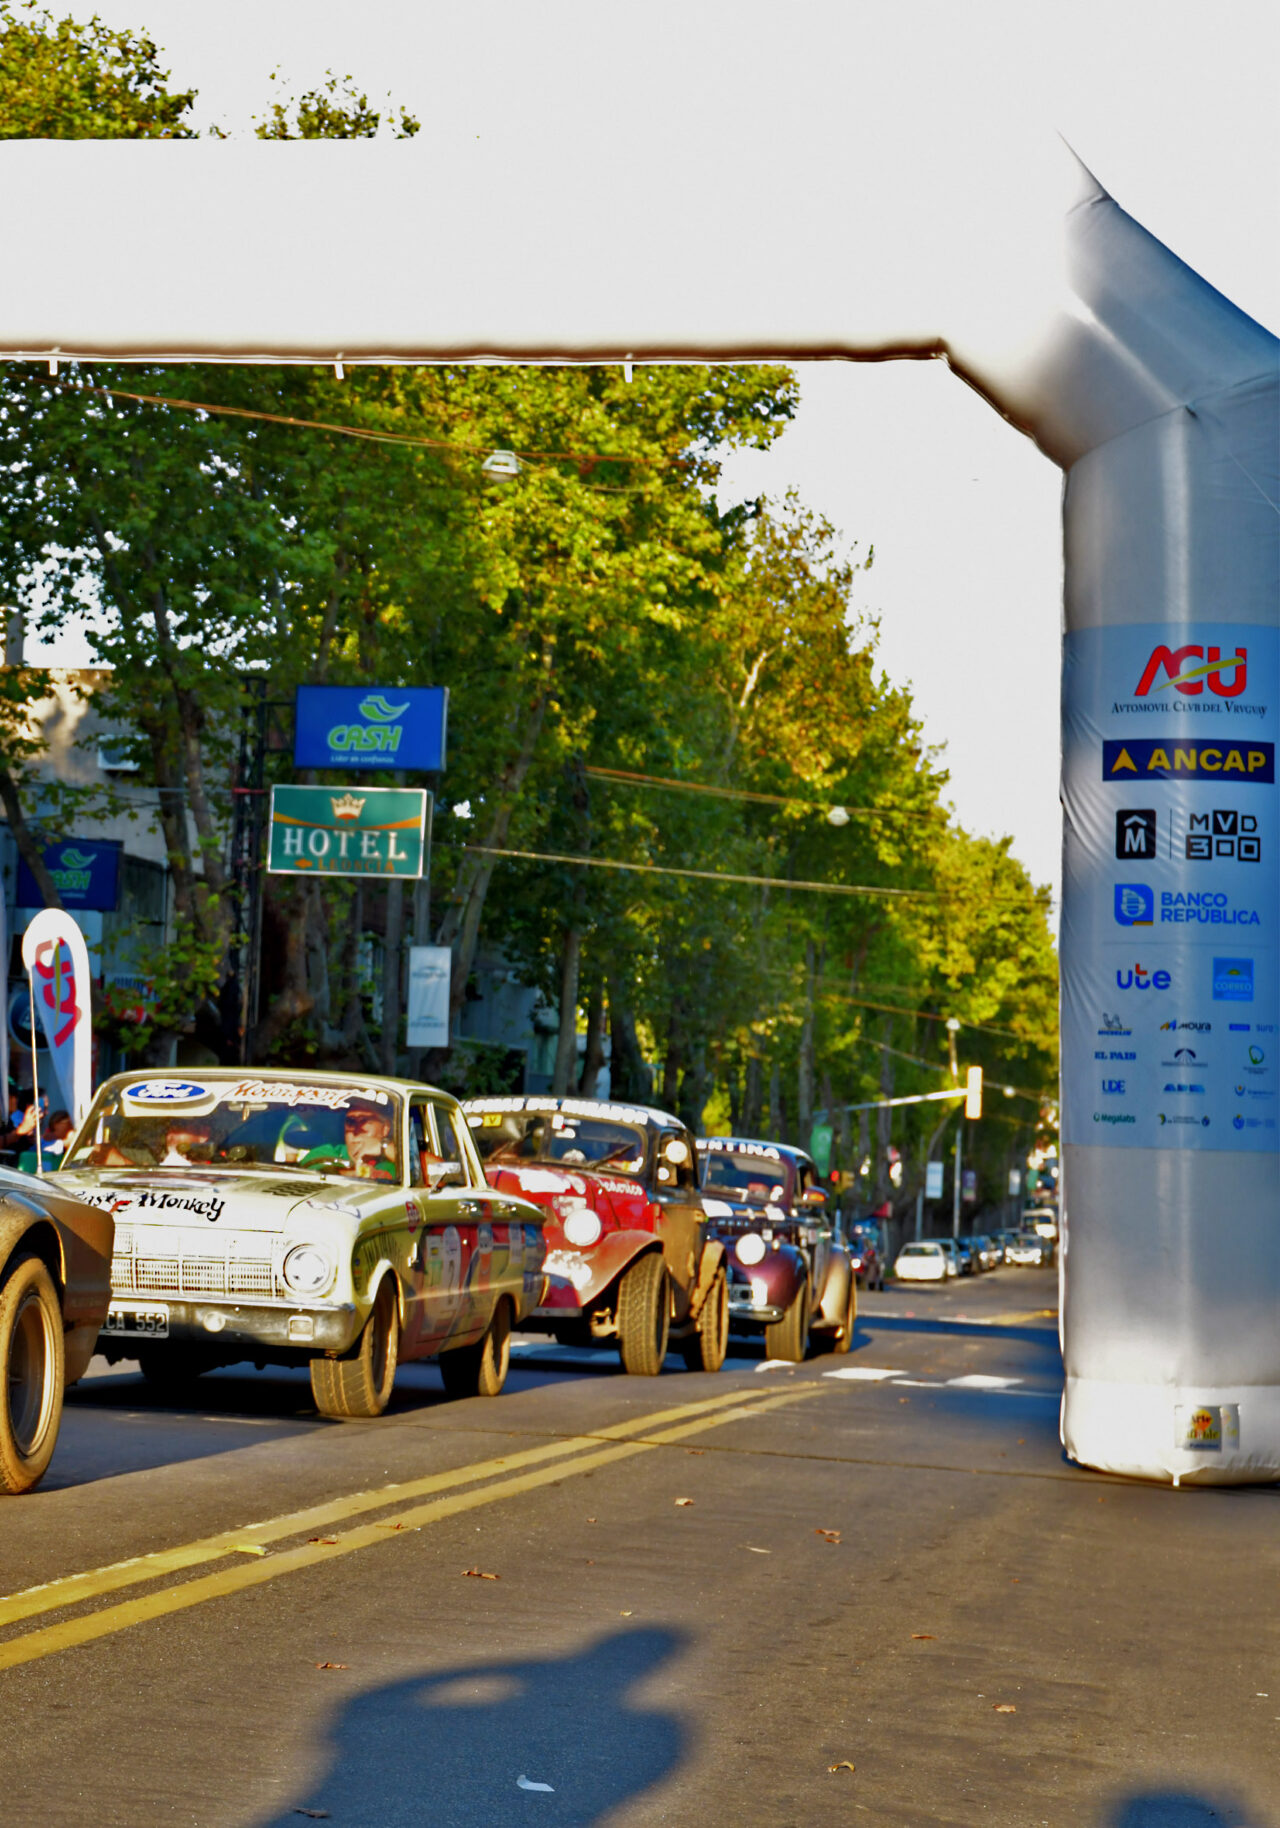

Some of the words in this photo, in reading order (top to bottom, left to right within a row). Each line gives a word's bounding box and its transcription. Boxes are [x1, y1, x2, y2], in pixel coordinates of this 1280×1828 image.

[1134, 644, 1247, 697] ACU
[328, 724, 403, 752] CASH
[1147, 748, 1266, 773] ANCAP
[283, 828, 407, 860] HOTEL
[318, 858, 395, 873] LEONCIA
[1161, 892, 1228, 907] BANCO
[1161, 907, 1260, 925] REPÚBLICA
[1117, 963, 1171, 990] ute
[139, 1083, 192, 1098] Ford
[138, 1192, 225, 1222] Monkey
[101, 1312, 126, 1330] CA
[135, 1313, 166, 1331] 552
